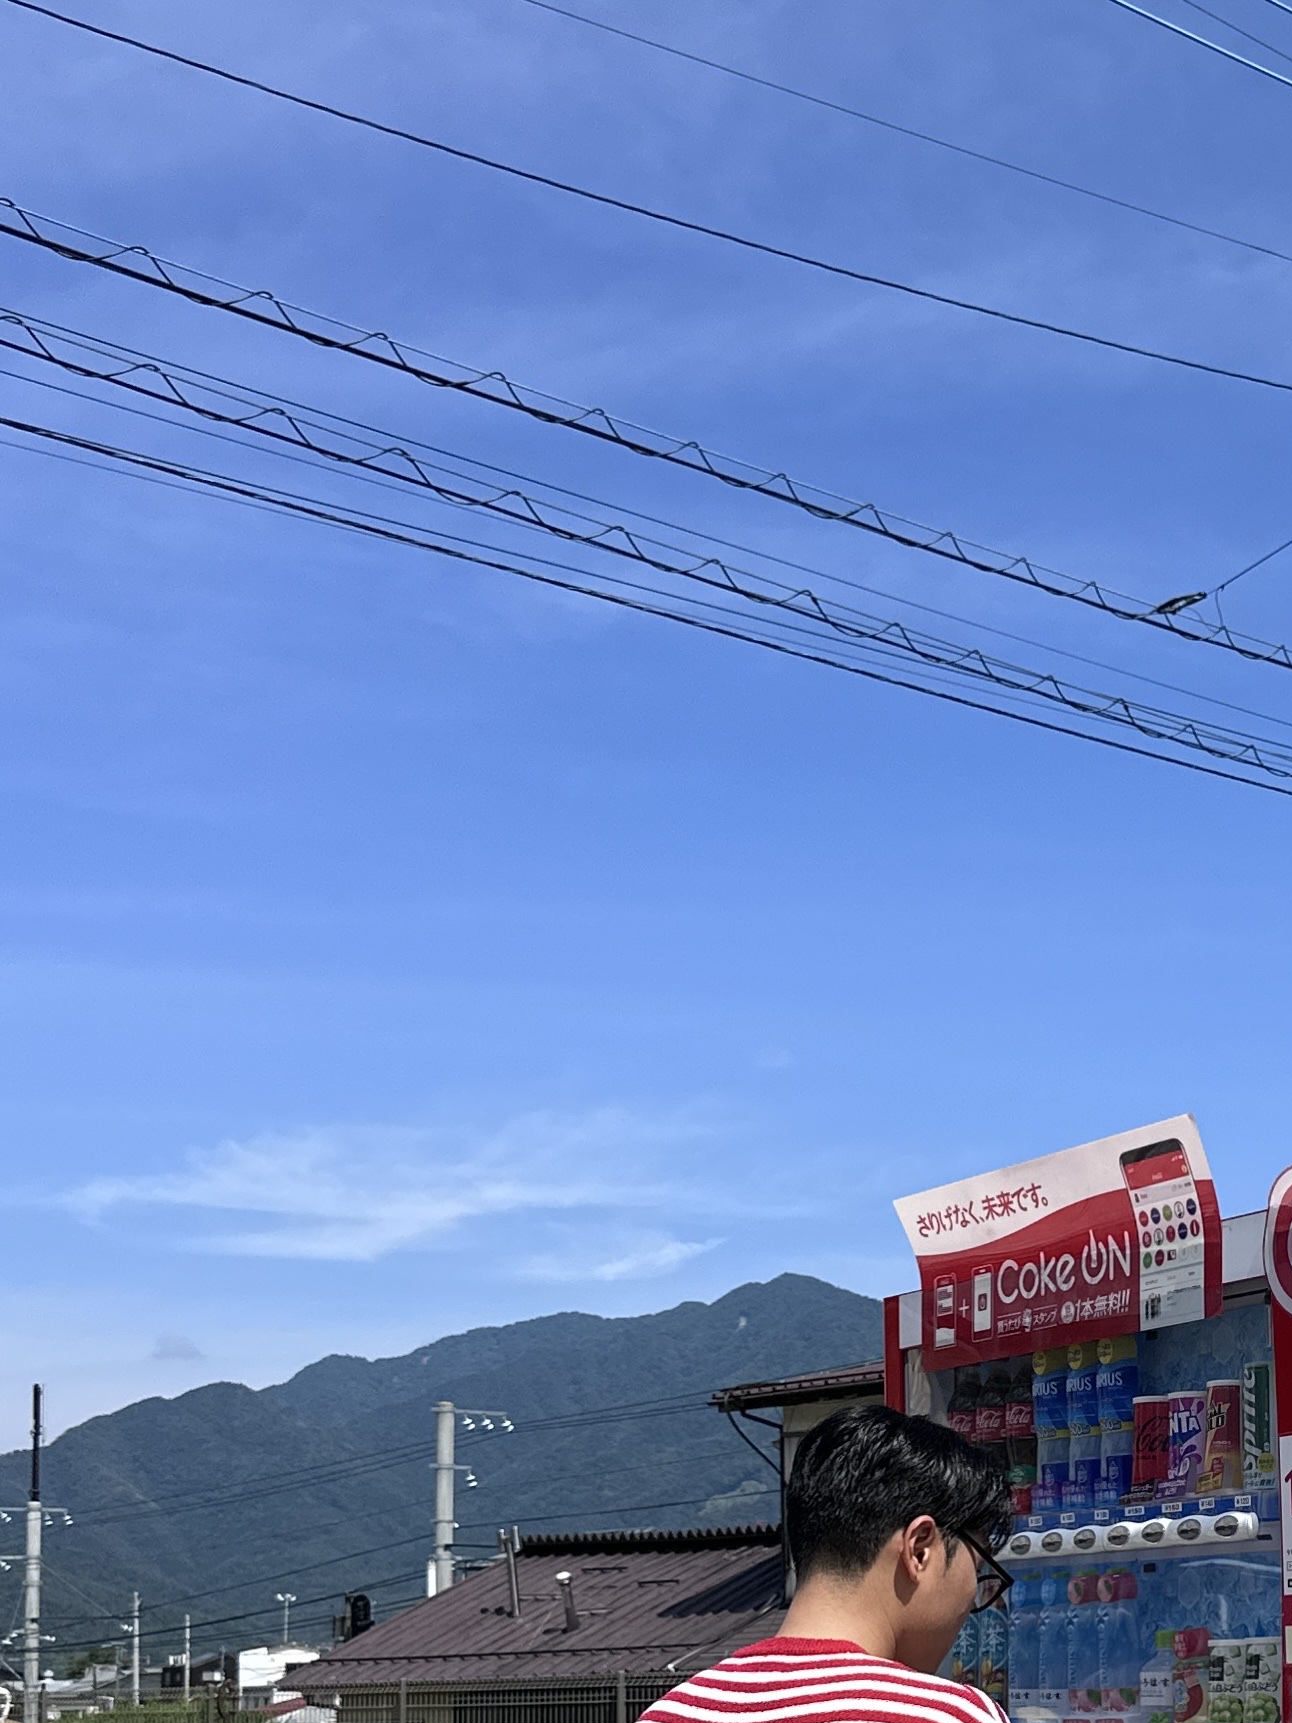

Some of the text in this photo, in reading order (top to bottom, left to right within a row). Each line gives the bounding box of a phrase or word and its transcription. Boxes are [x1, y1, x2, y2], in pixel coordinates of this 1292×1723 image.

[916, 1182, 1049, 1238] さりげなく、未来です。
[997, 1228, 1131, 1304] Coke ON
